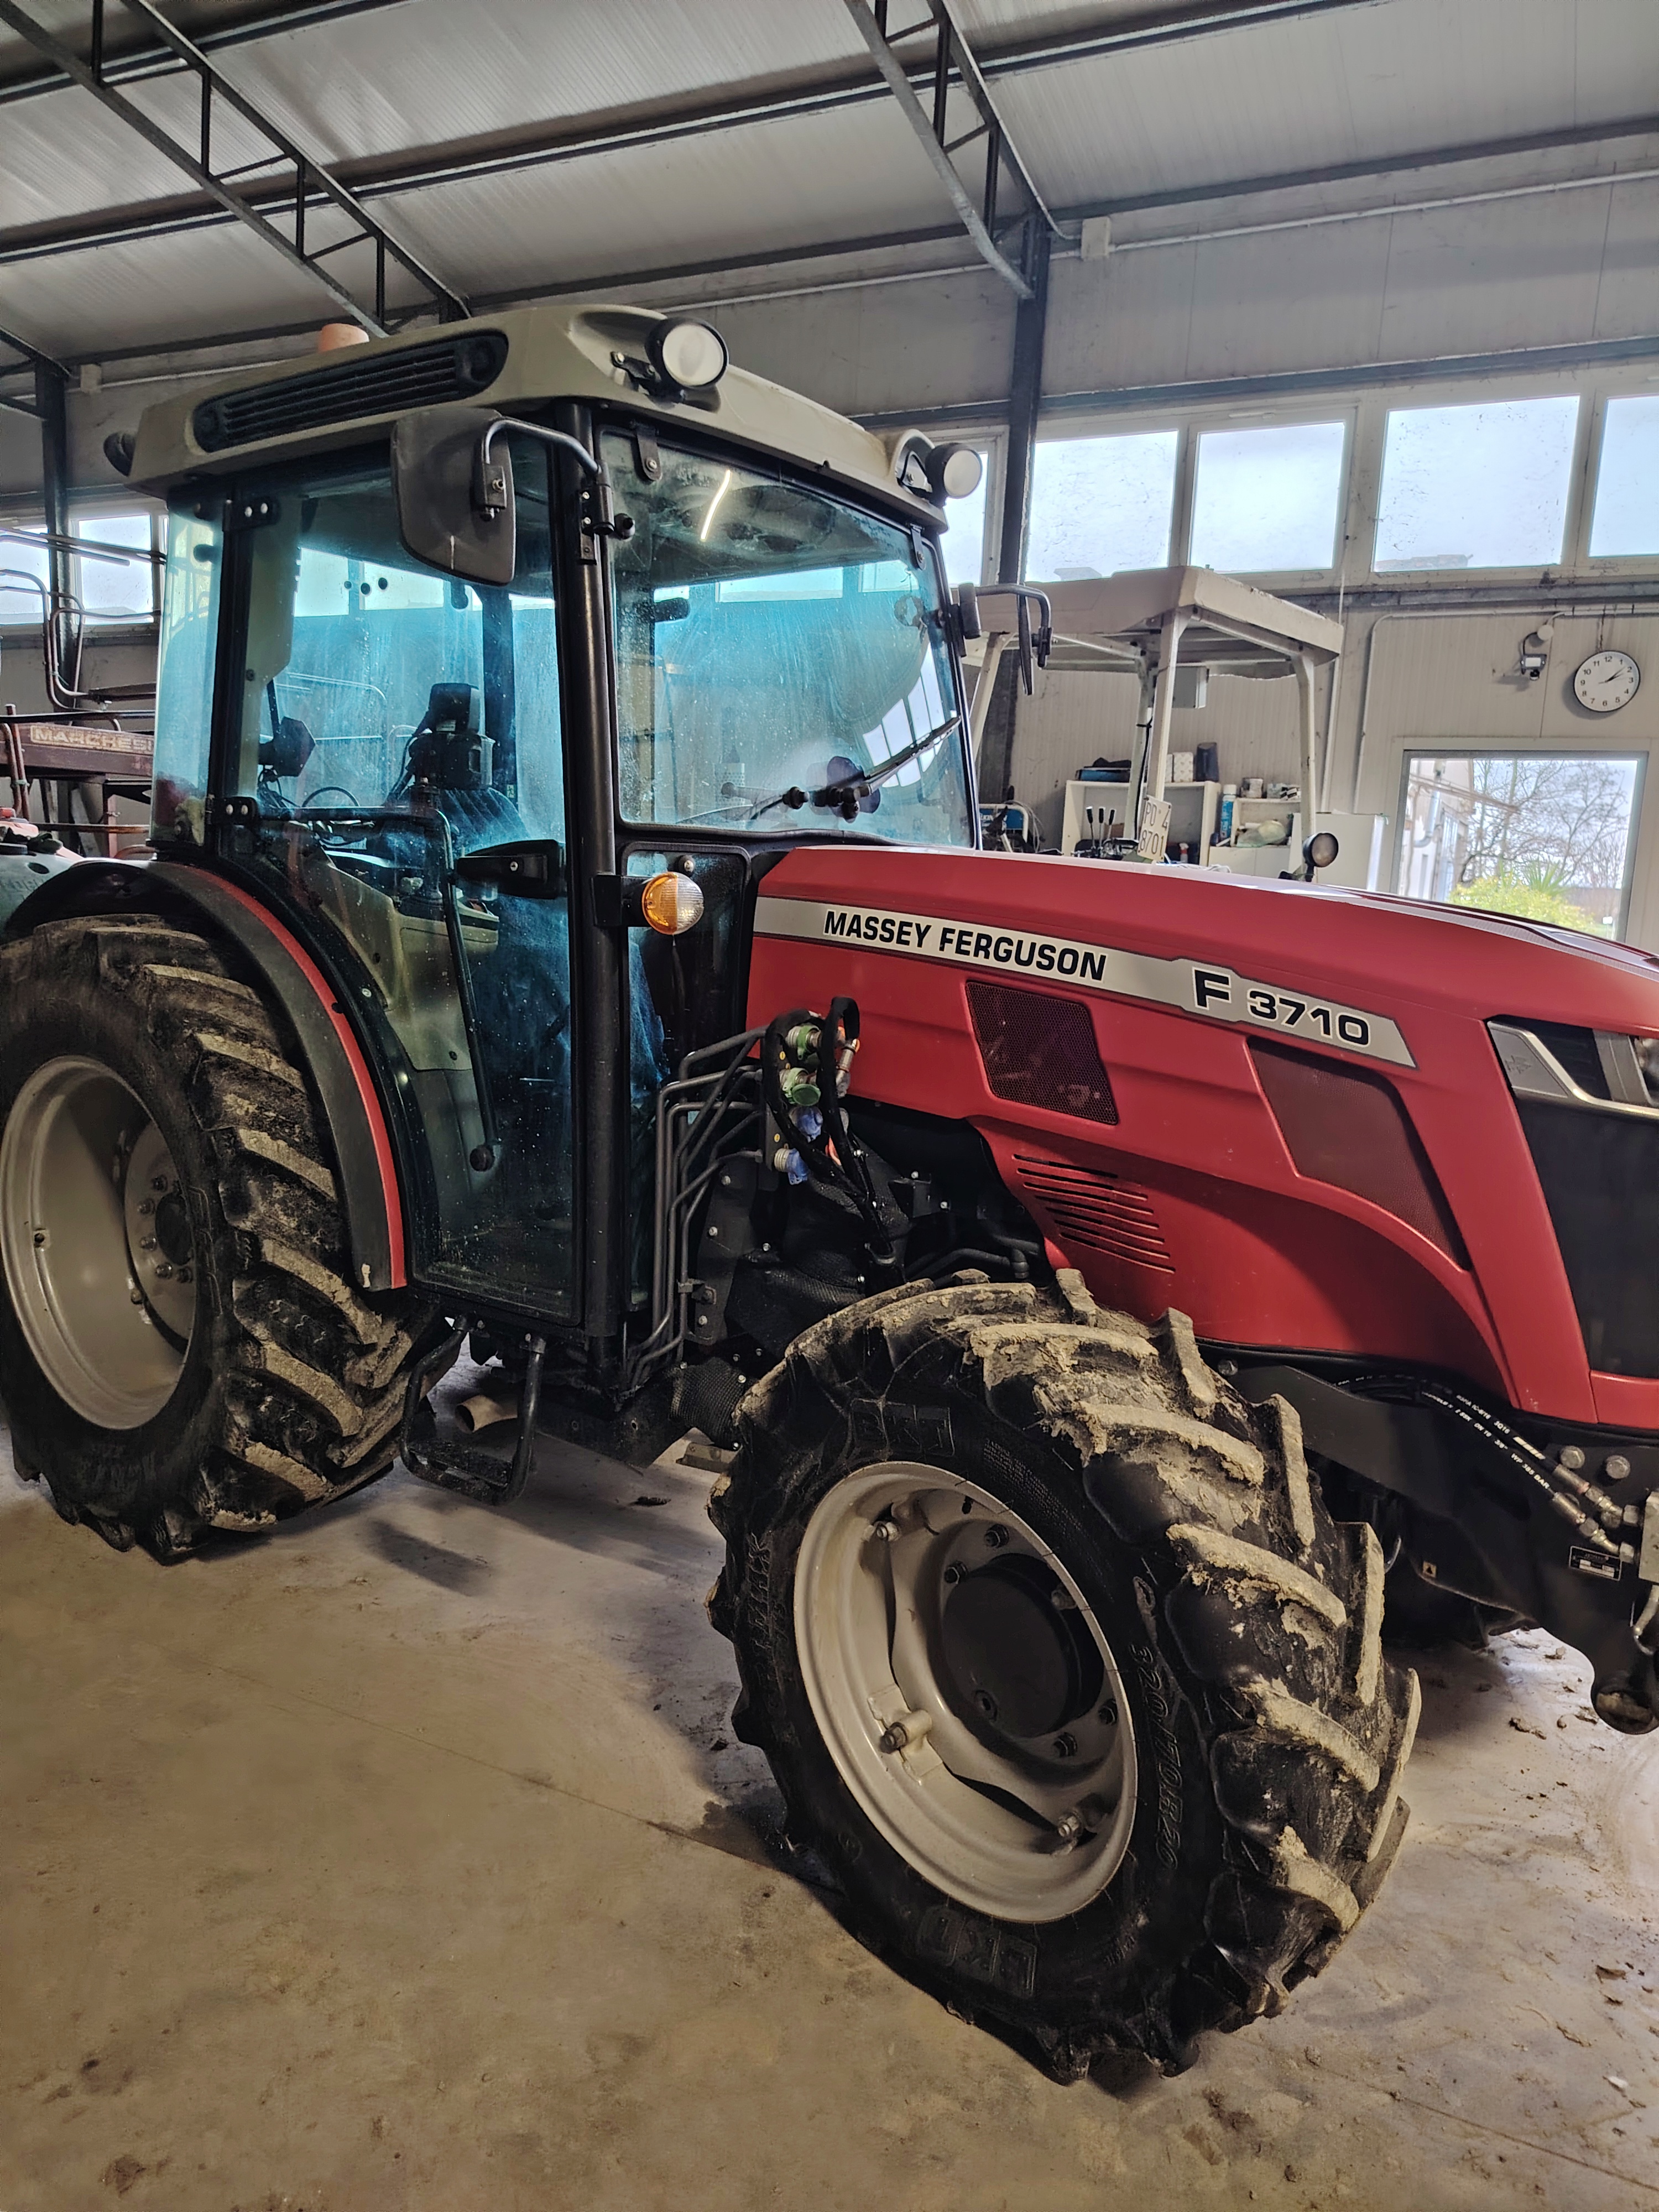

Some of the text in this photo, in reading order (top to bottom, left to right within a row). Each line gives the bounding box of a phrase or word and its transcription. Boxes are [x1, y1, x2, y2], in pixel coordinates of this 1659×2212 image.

[1144, 802, 1170, 831] PD 4
[1140, 830, 1165, 857] 8701
[823, 910, 1107, 981] MASSEY FERGUSON
[1193, 968, 1370, 1046] F 3710
[1511, 1453, 1524, 1464] WP
[1522, 1463, 1535, 1475] 385
[1533, 1474, 1550, 1489] BAR
